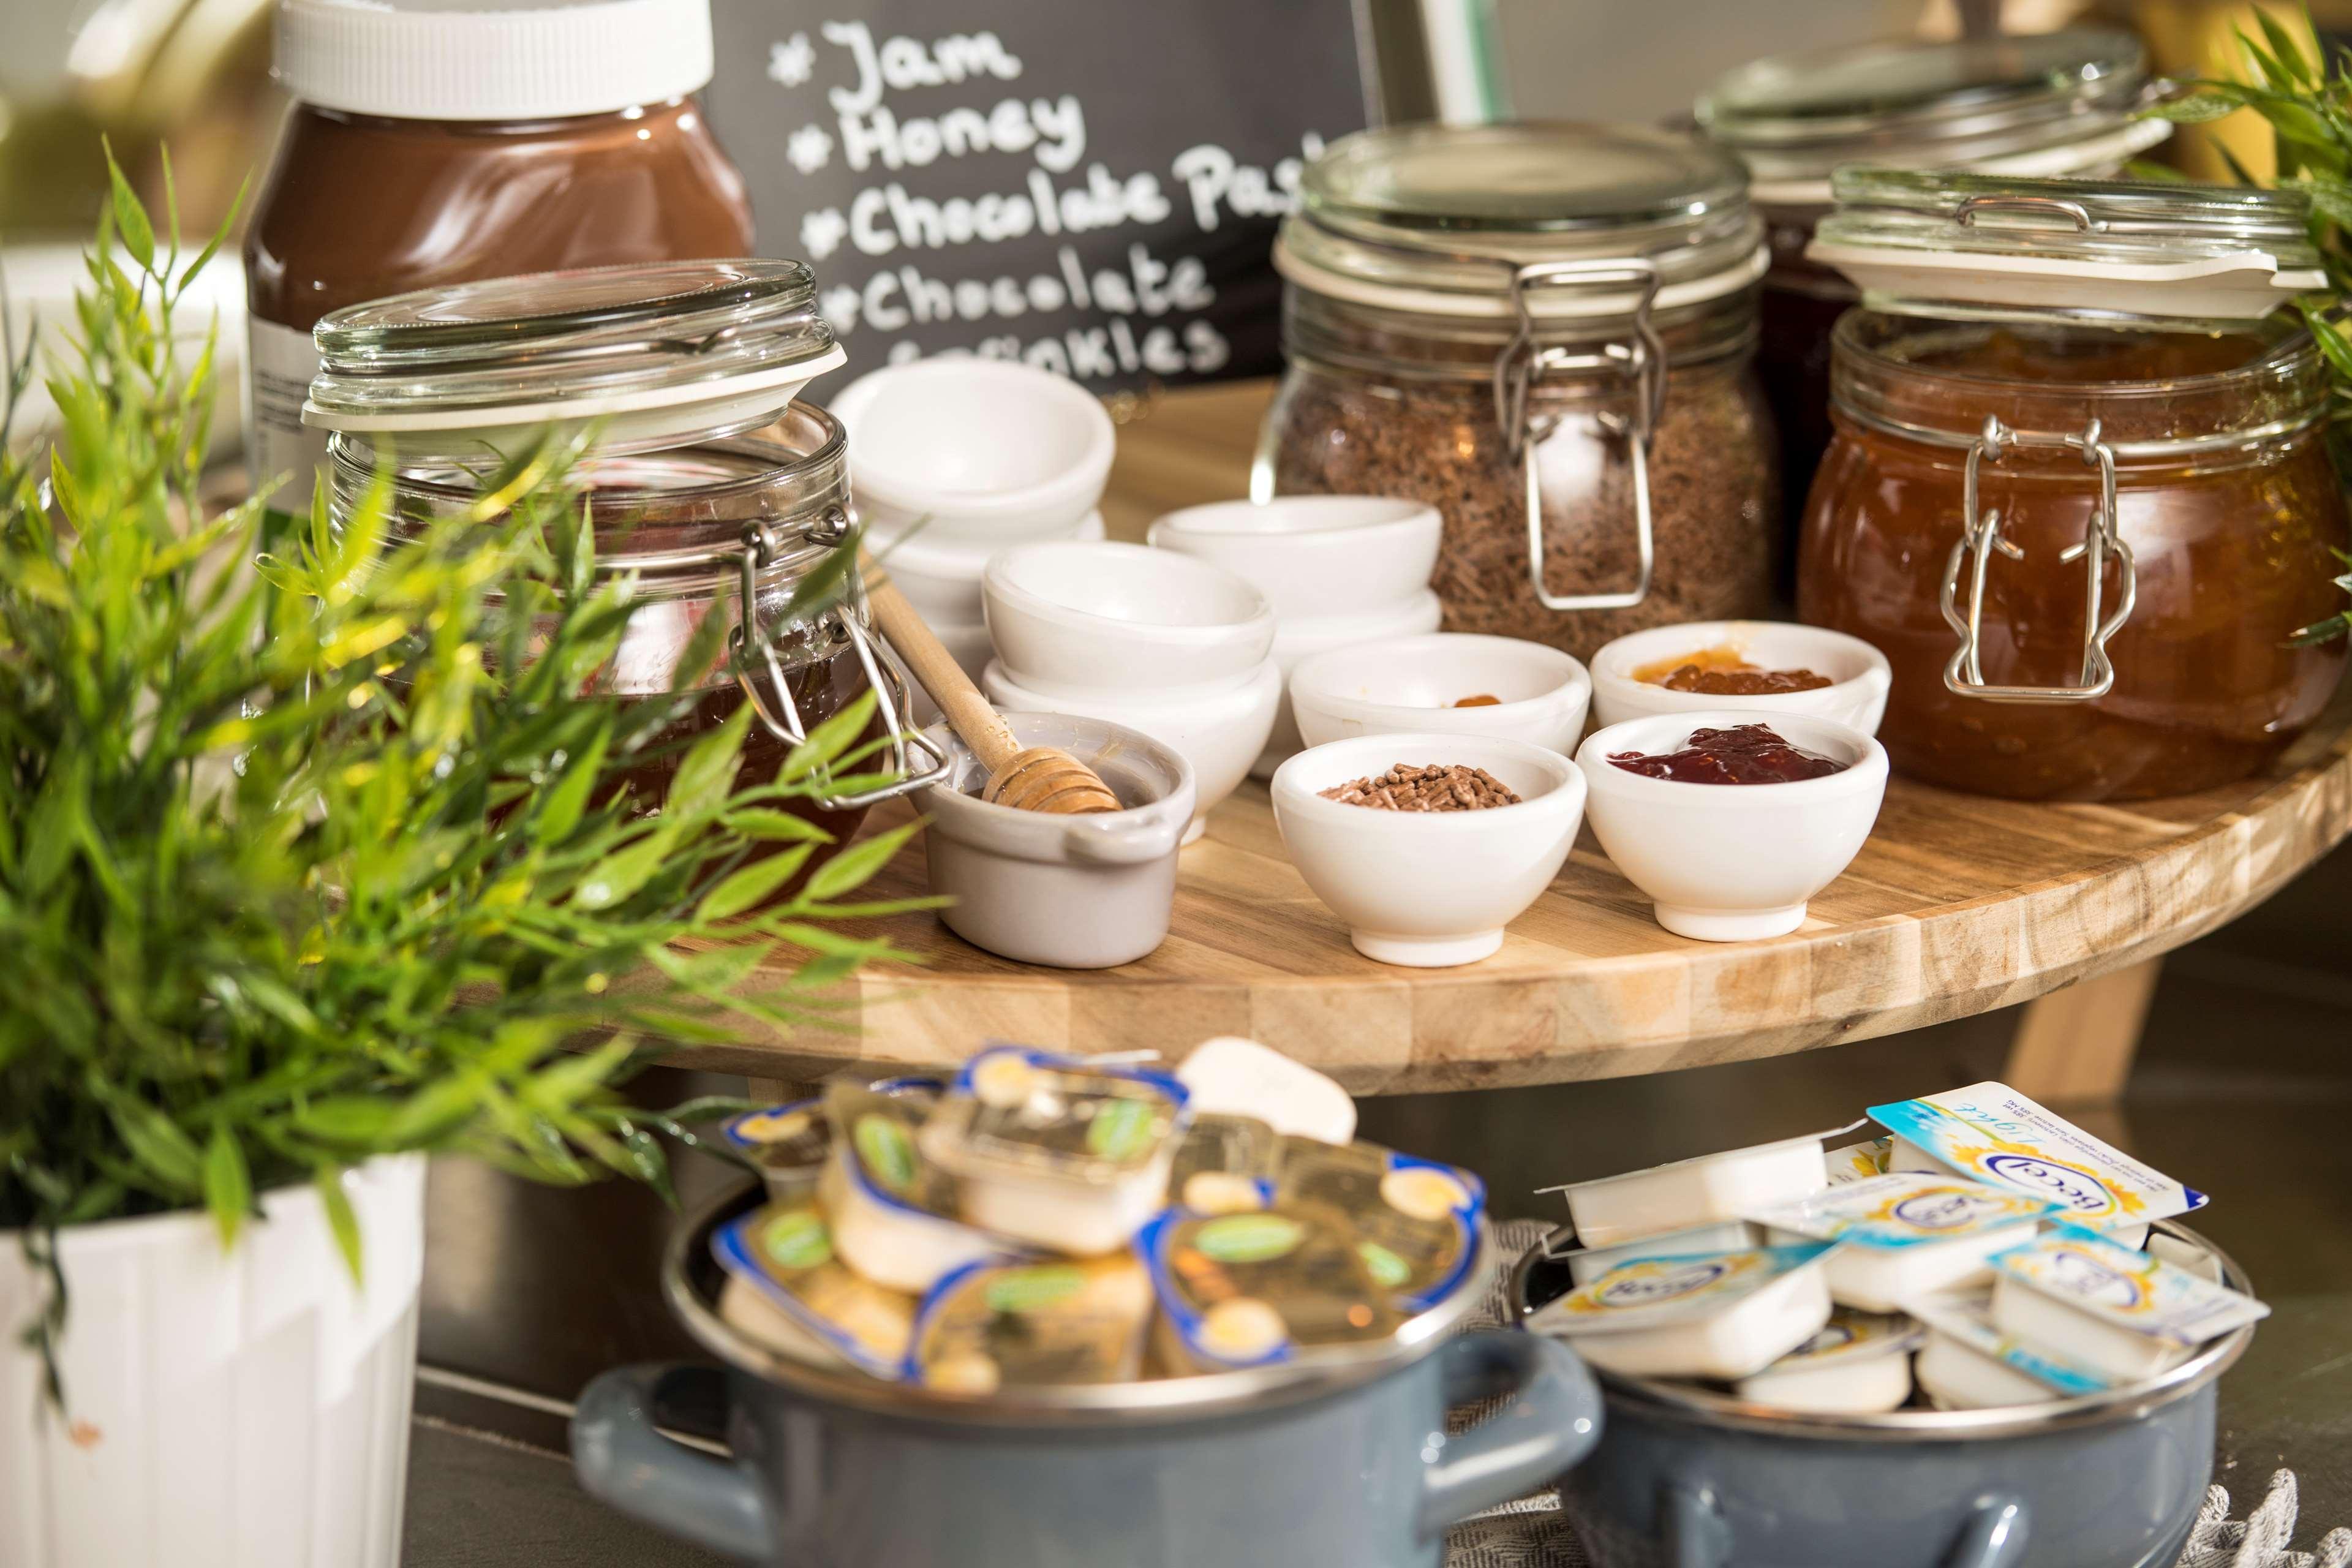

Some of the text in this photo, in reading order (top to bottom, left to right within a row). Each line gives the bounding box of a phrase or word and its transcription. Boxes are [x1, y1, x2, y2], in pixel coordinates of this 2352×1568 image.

[821, 19, 1023, 116] Jam
[837, 94, 1087, 174] Honey
[849, 129, 1324, 256] Chocolate Pas
[862, 243, 1216, 332] Chocolate
[2007, 1161, 2105, 1210] Becel
